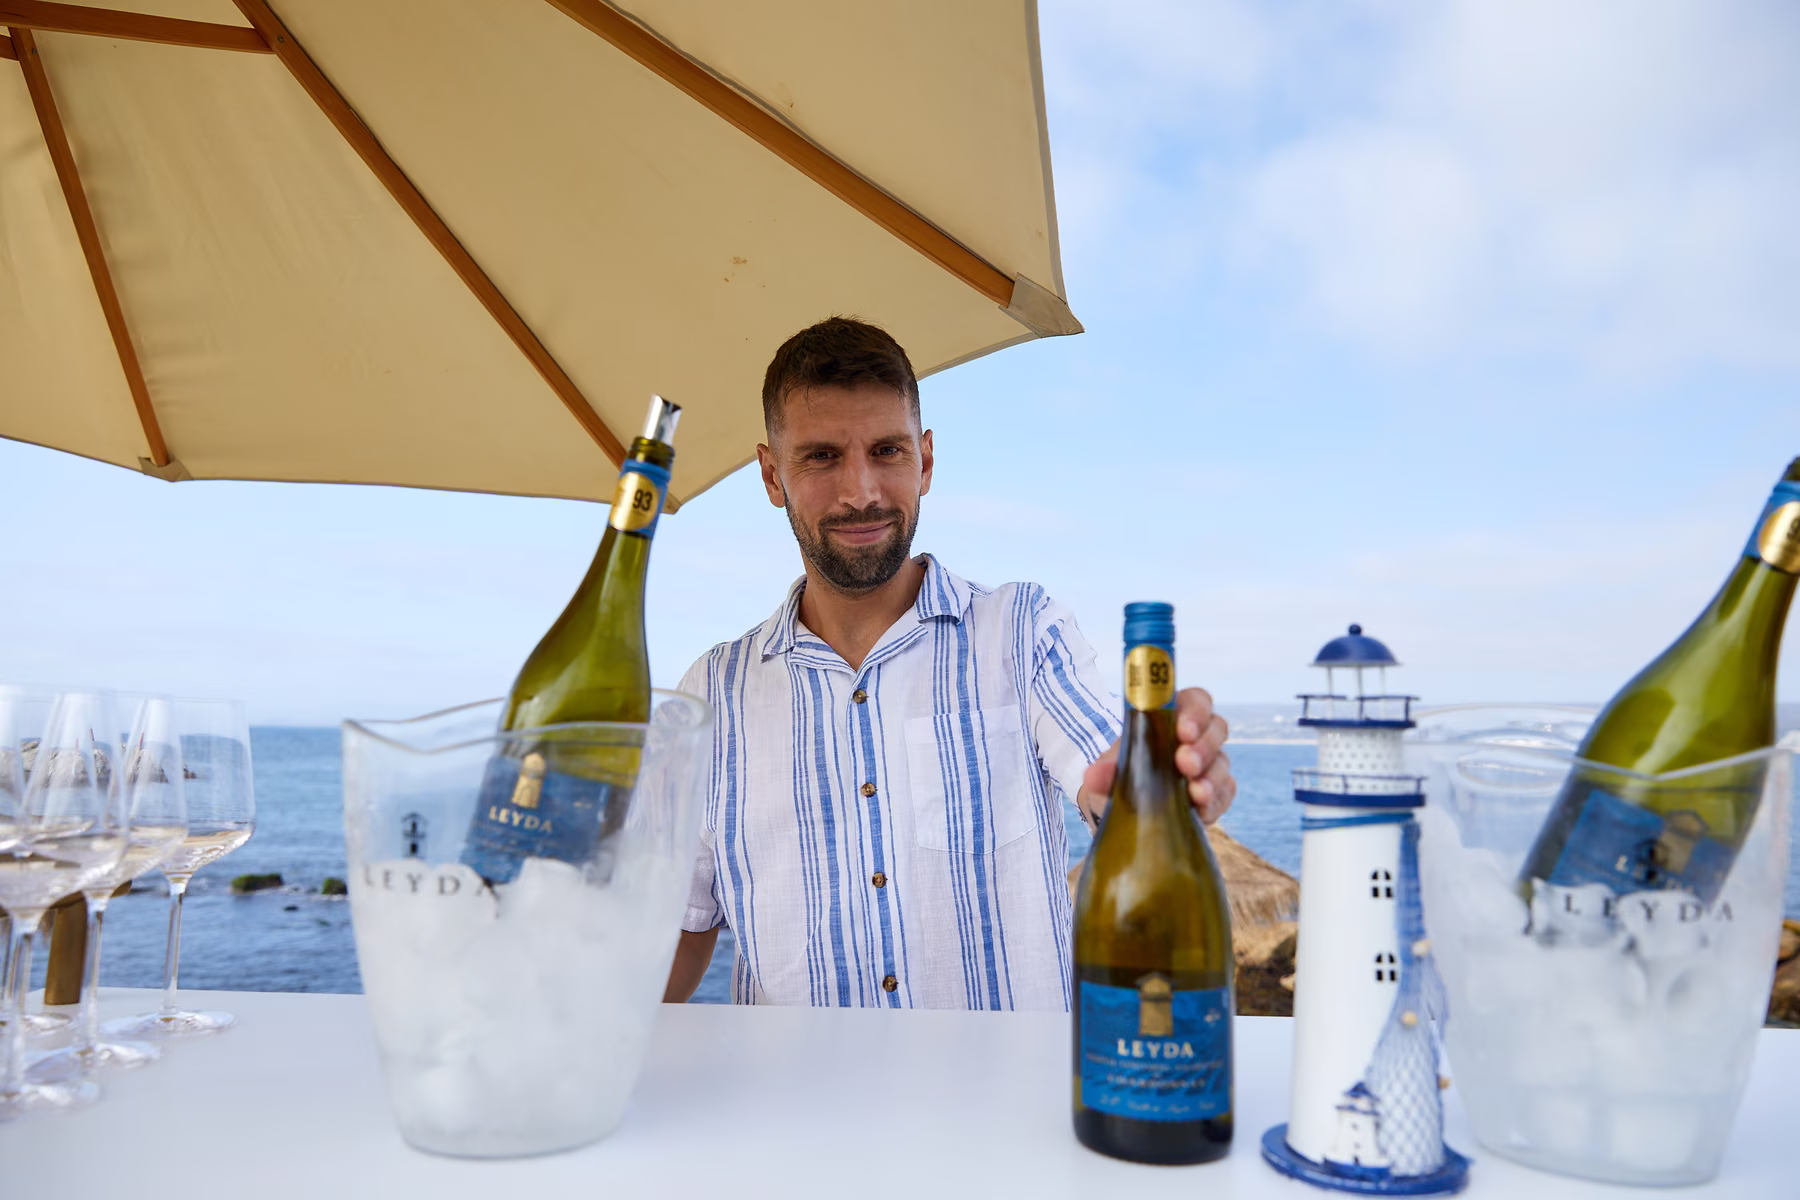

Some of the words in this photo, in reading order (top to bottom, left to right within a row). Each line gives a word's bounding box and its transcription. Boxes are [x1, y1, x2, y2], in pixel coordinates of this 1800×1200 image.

[632, 489, 653, 512] 93
[1149, 661, 1169, 685] 93
[488, 805, 553, 833] LEYDA
[1117, 1038, 1194, 1059] LEYDA
